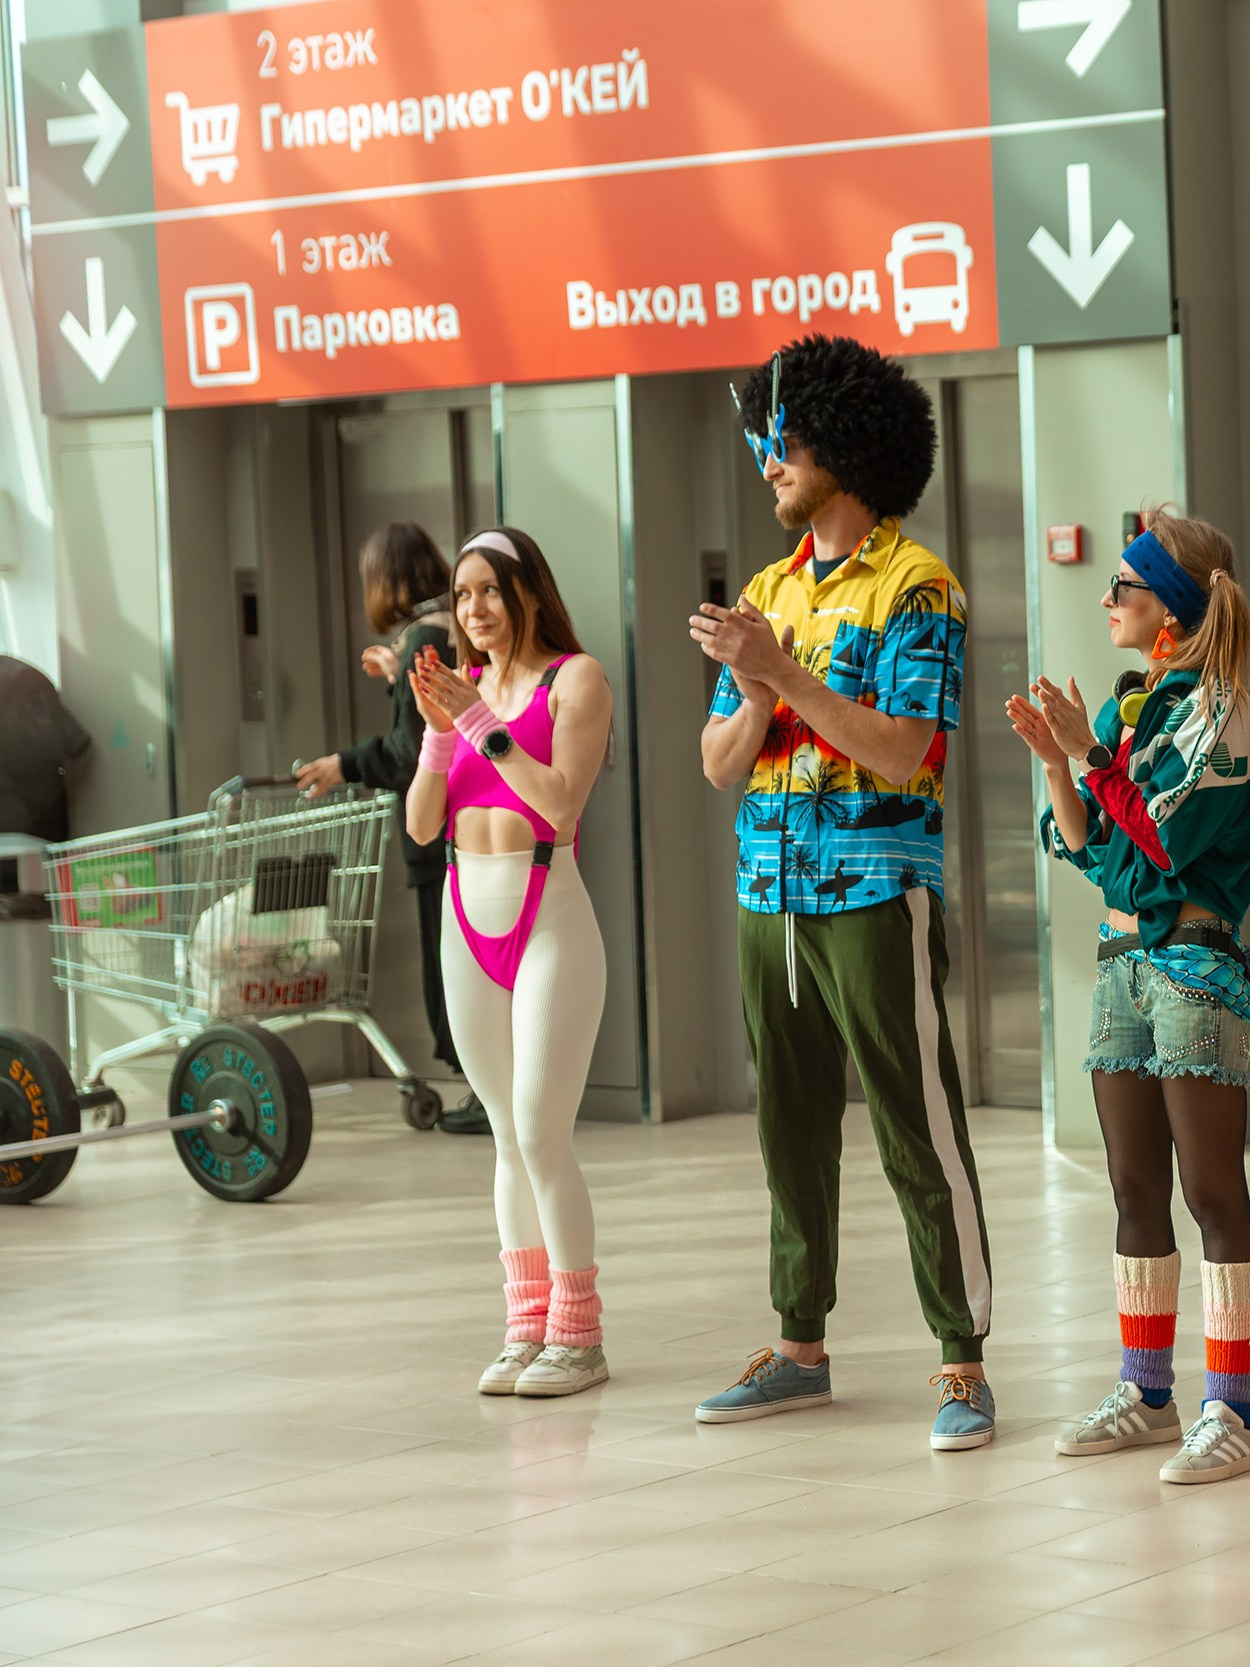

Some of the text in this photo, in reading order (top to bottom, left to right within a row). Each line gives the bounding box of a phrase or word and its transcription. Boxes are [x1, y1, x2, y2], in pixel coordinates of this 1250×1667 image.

[257, 28, 378, 78] 2 этаж
[259, 48, 649, 152] Гипермаркет О'КЕЙ
[270, 230, 393, 275] 1 этаж
[565, 268, 880, 330] Выход в город
[203, 299, 241, 371] P
[273, 302, 460, 359] Парковка
[223, 1046, 277, 1136] STECTER
